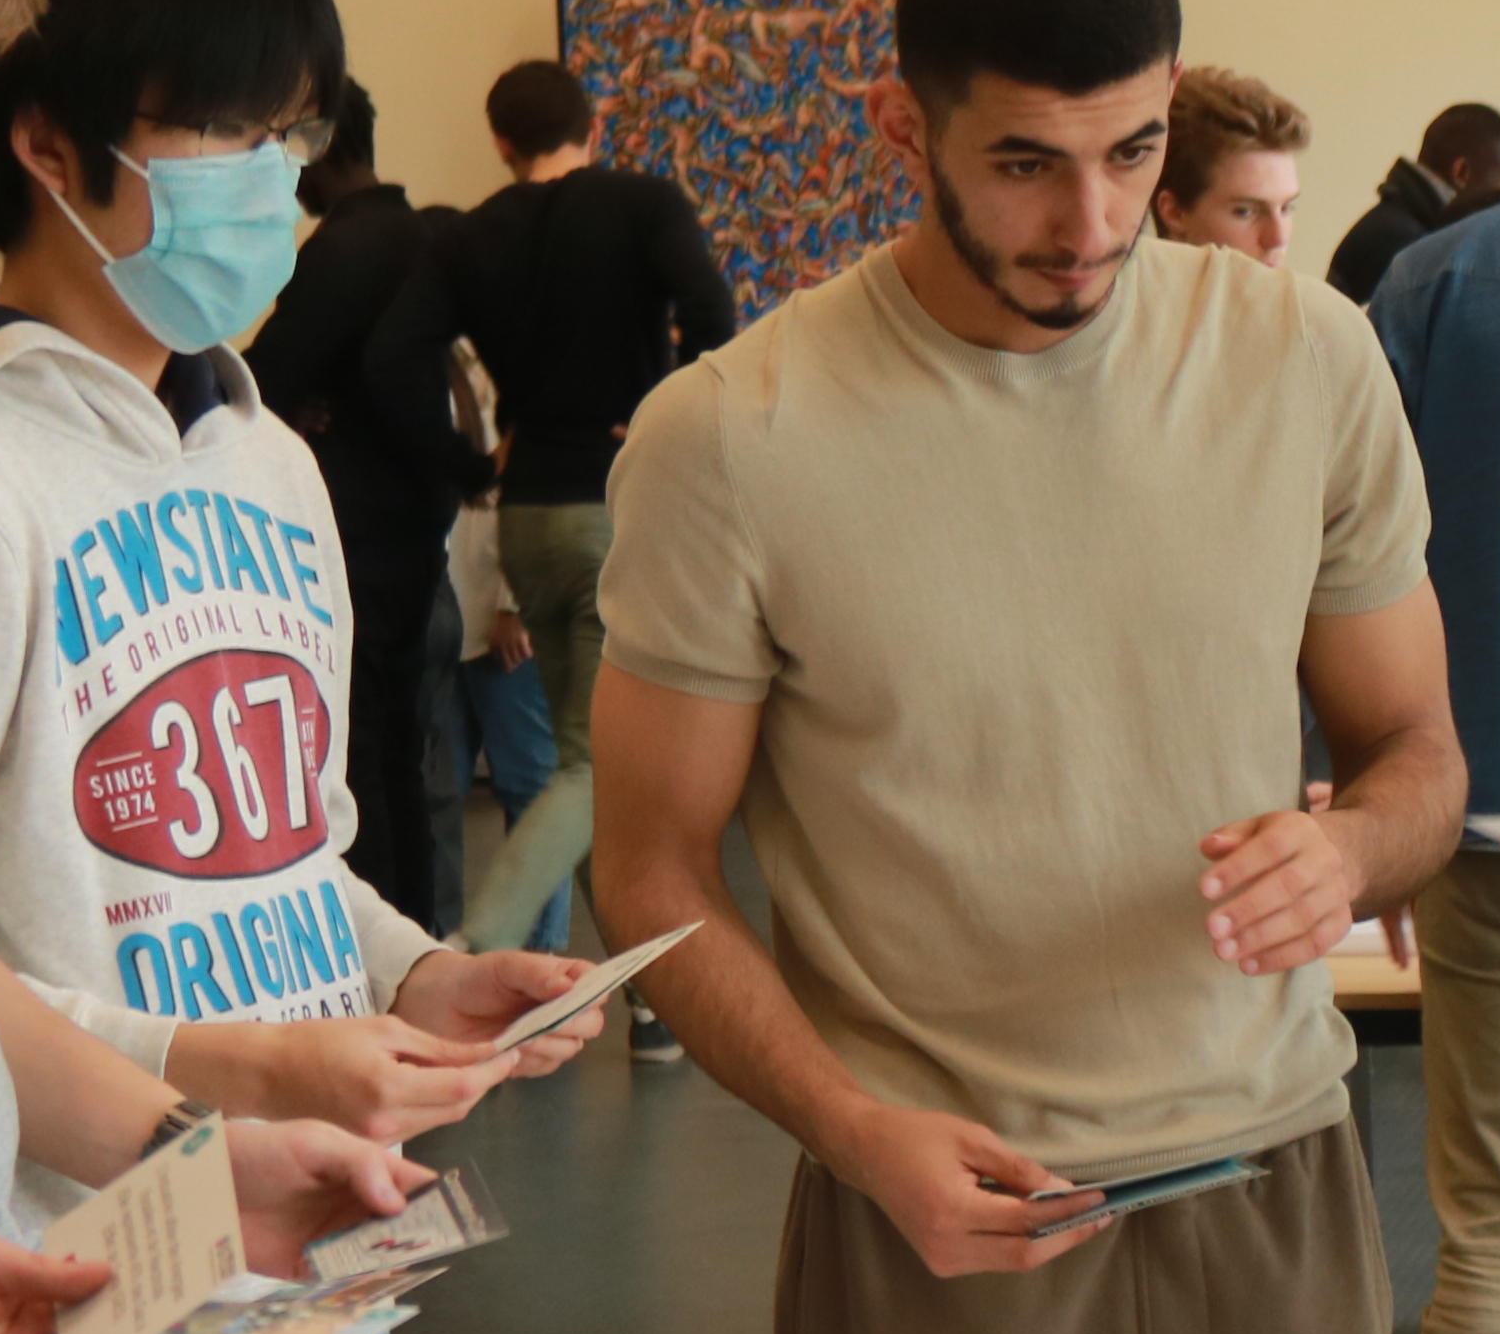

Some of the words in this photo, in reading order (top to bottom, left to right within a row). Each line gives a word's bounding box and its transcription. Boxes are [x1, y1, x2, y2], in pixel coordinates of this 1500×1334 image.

[54, 488, 334, 688] NEWSTATE
[61, 663, 118, 734] THE
[127, 603, 244, 673] ORIGINAL
[256, 608, 336, 675] LABEL
[89, 761, 157, 799] SINCE
[104, 790, 157, 823] 1974
[151, 673, 312, 859] 367
[105, 892, 173, 927] MMXVII
[115, 879, 362, 1022] ORIGINA
